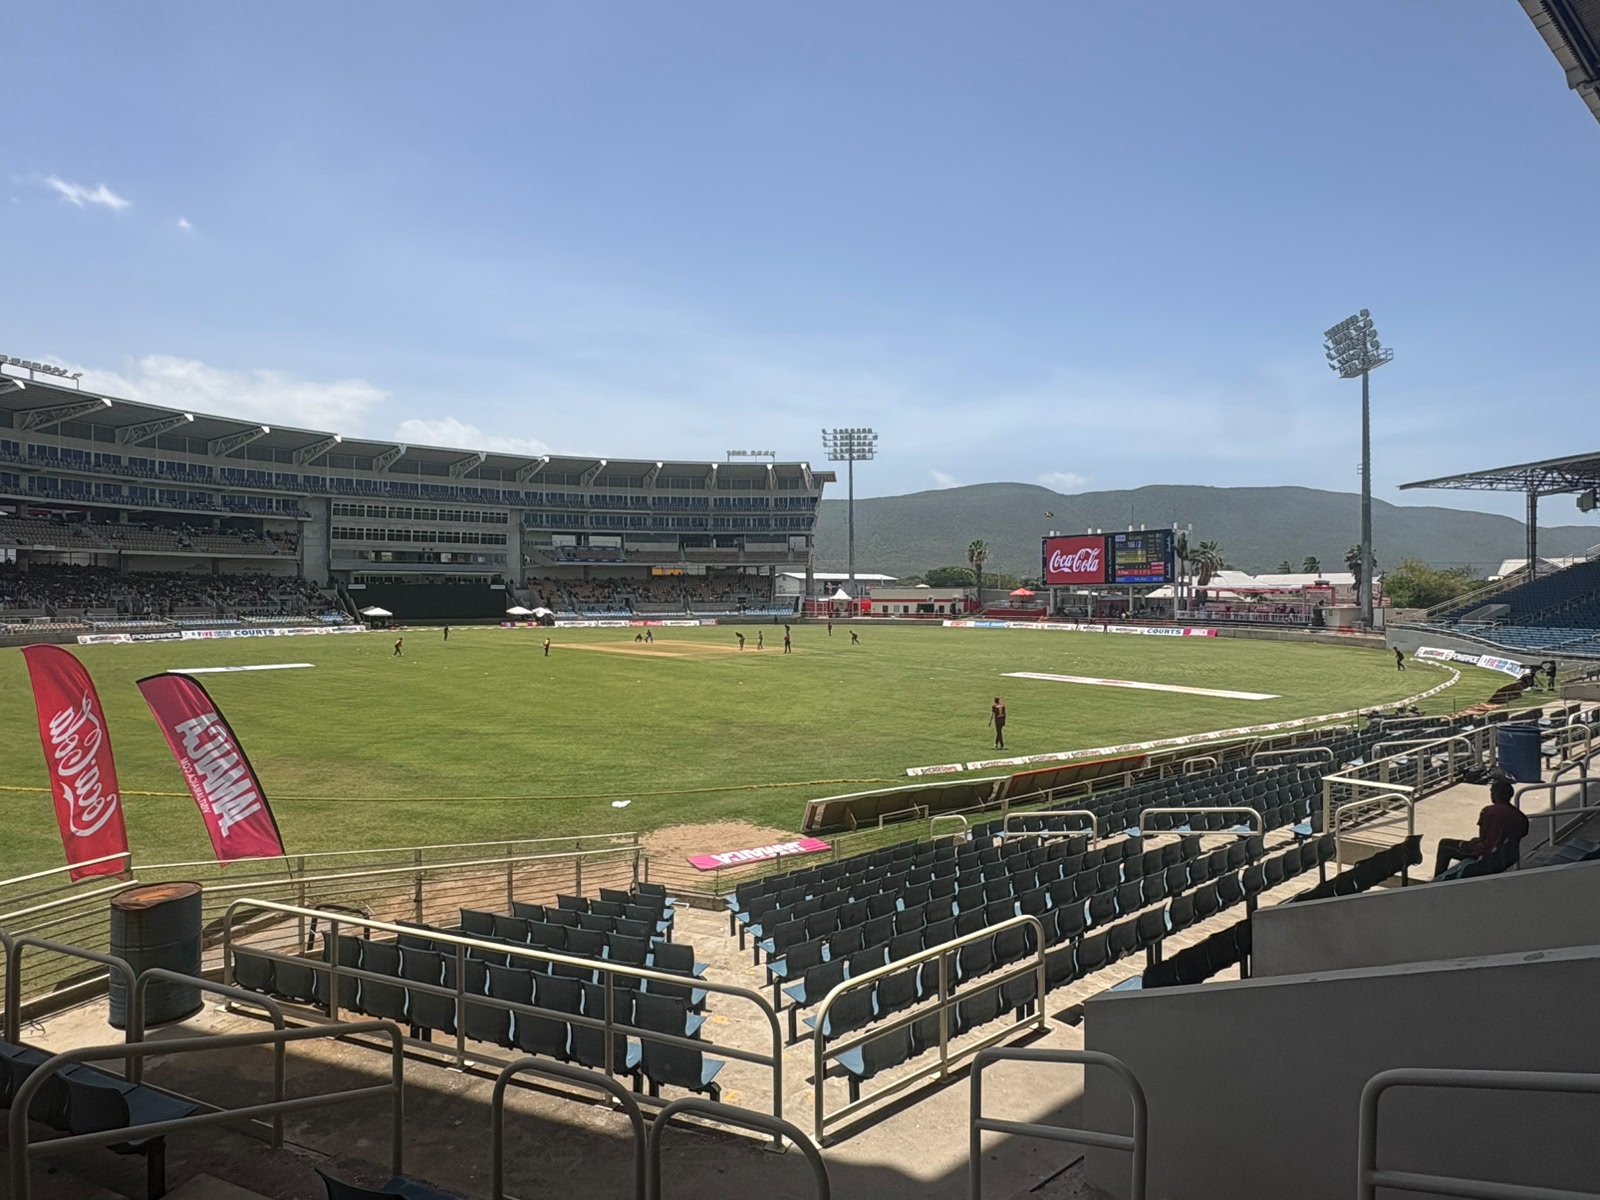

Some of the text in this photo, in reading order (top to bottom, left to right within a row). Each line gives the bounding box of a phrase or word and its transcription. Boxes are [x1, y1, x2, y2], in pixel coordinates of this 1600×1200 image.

[1050, 547, 1101, 573] Coca-Cola
[132, 631, 181, 640] POWERADE
[1147, 627, 1181, 635] COURTS
